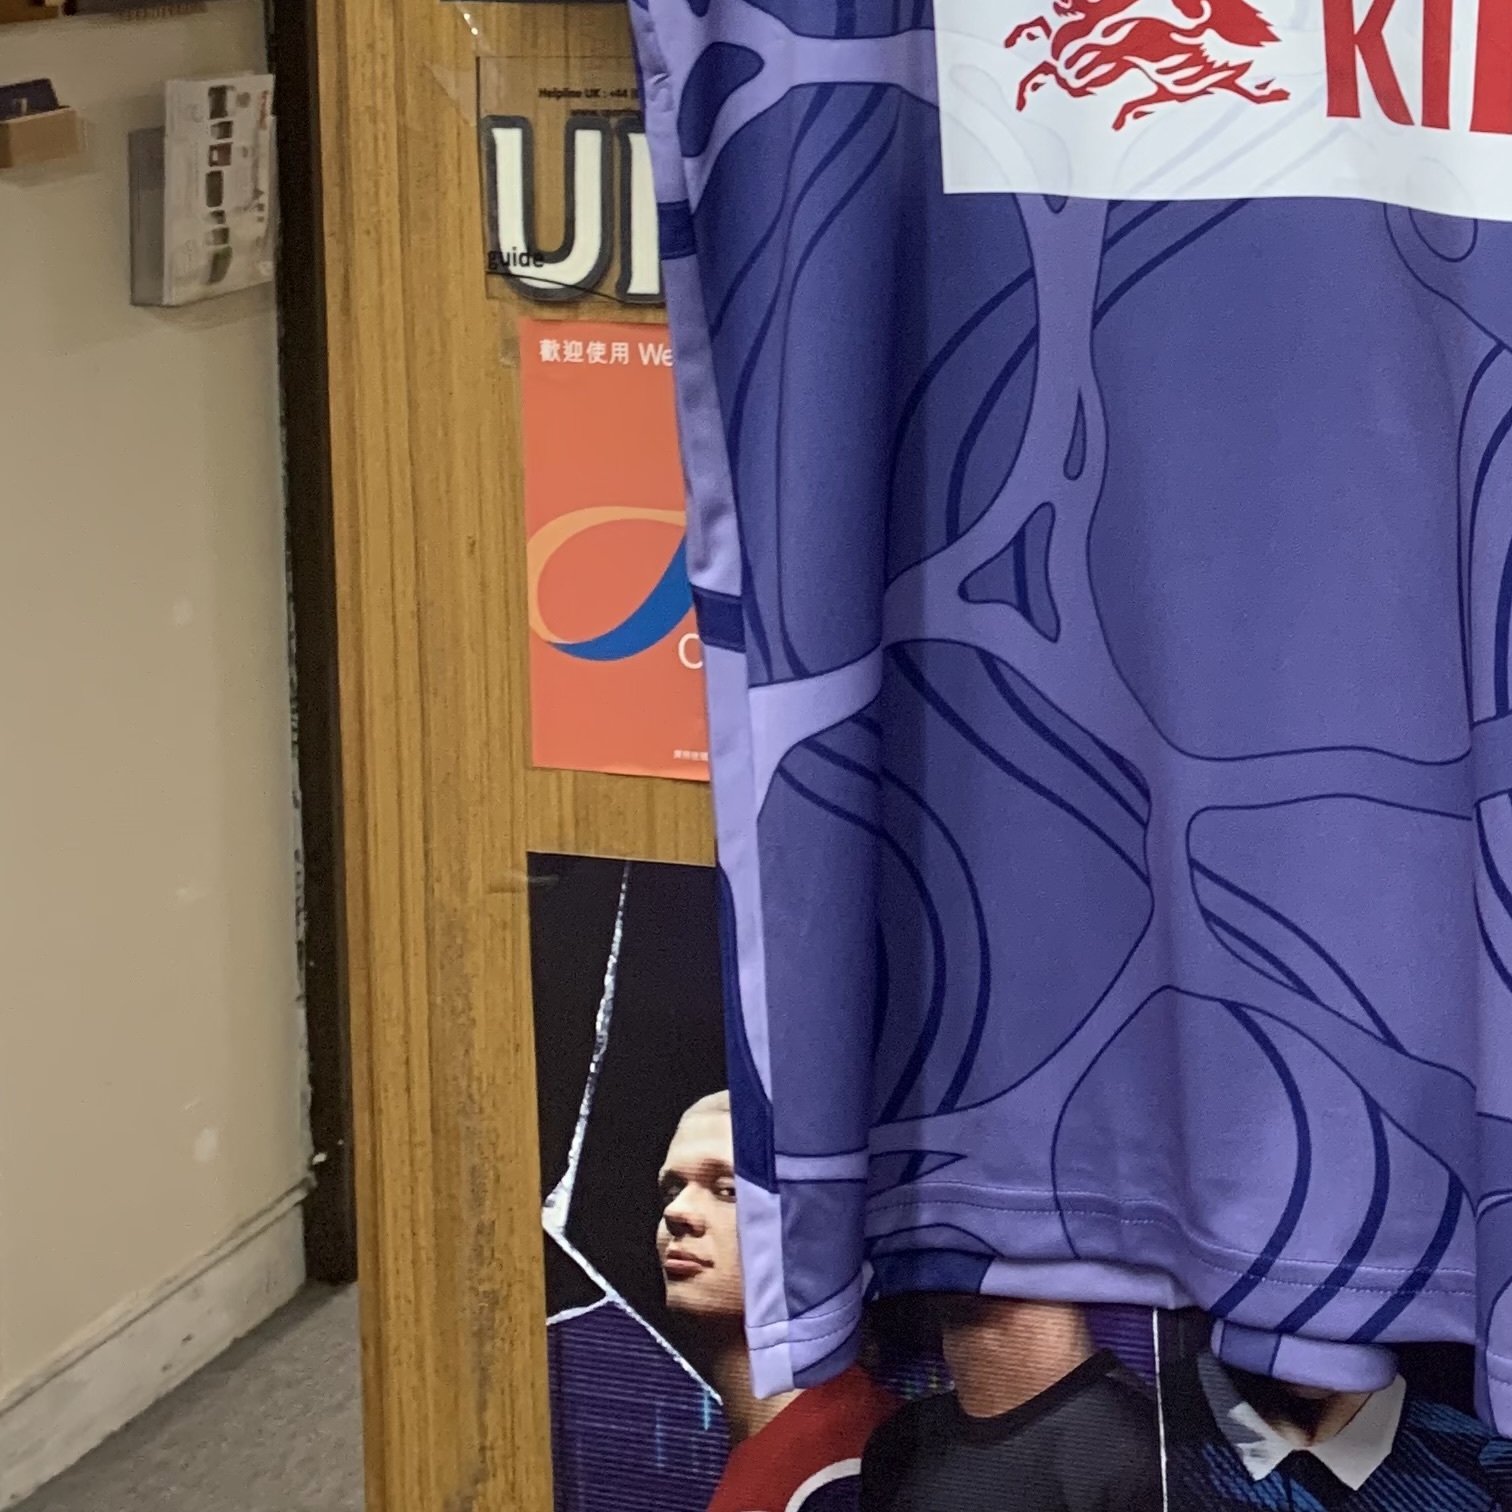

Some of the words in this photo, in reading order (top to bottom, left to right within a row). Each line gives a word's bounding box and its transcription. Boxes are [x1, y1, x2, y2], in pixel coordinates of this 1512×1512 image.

[488, 246, 544, 271] guide
[539, 339, 630, 365] 歡迎使用
